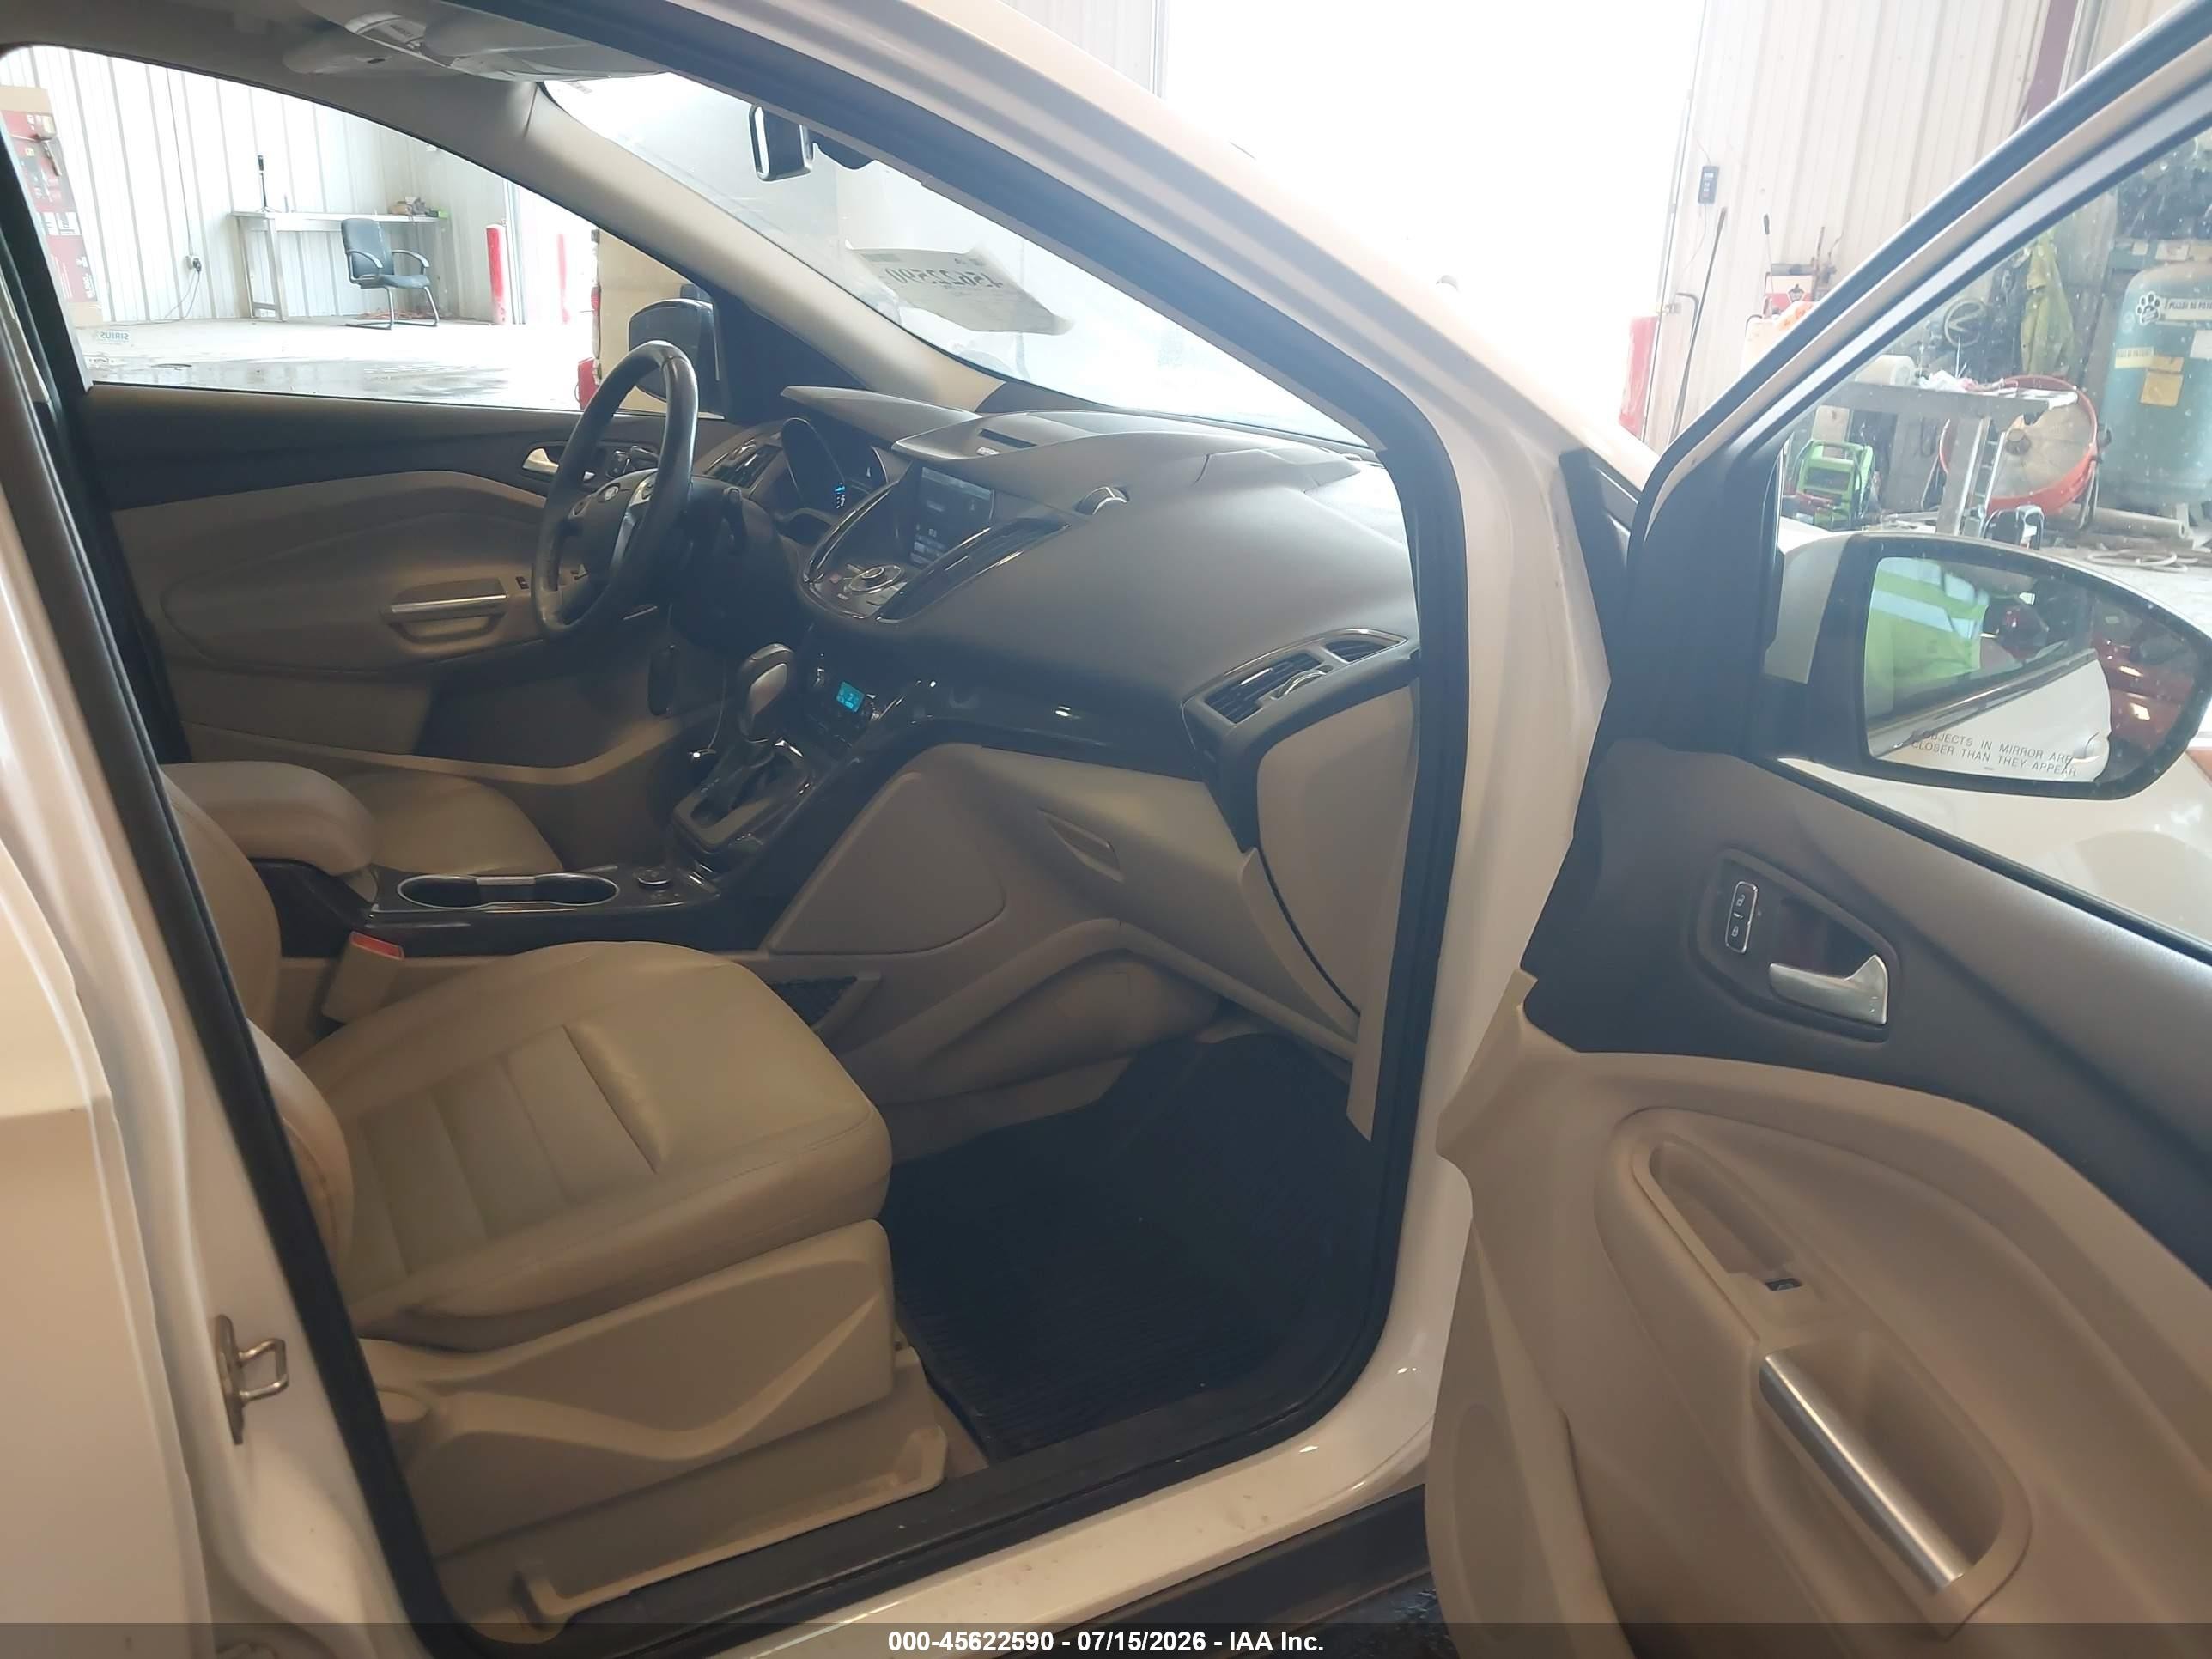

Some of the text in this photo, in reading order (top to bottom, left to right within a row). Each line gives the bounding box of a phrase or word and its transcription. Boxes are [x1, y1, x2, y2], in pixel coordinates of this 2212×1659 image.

[1911, 741, 2076, 776] CLOSER THAN THEY APPEAR
[1980, 739, 1992, 750] IN
[1999, 743, 2044, 758] MIRROR
